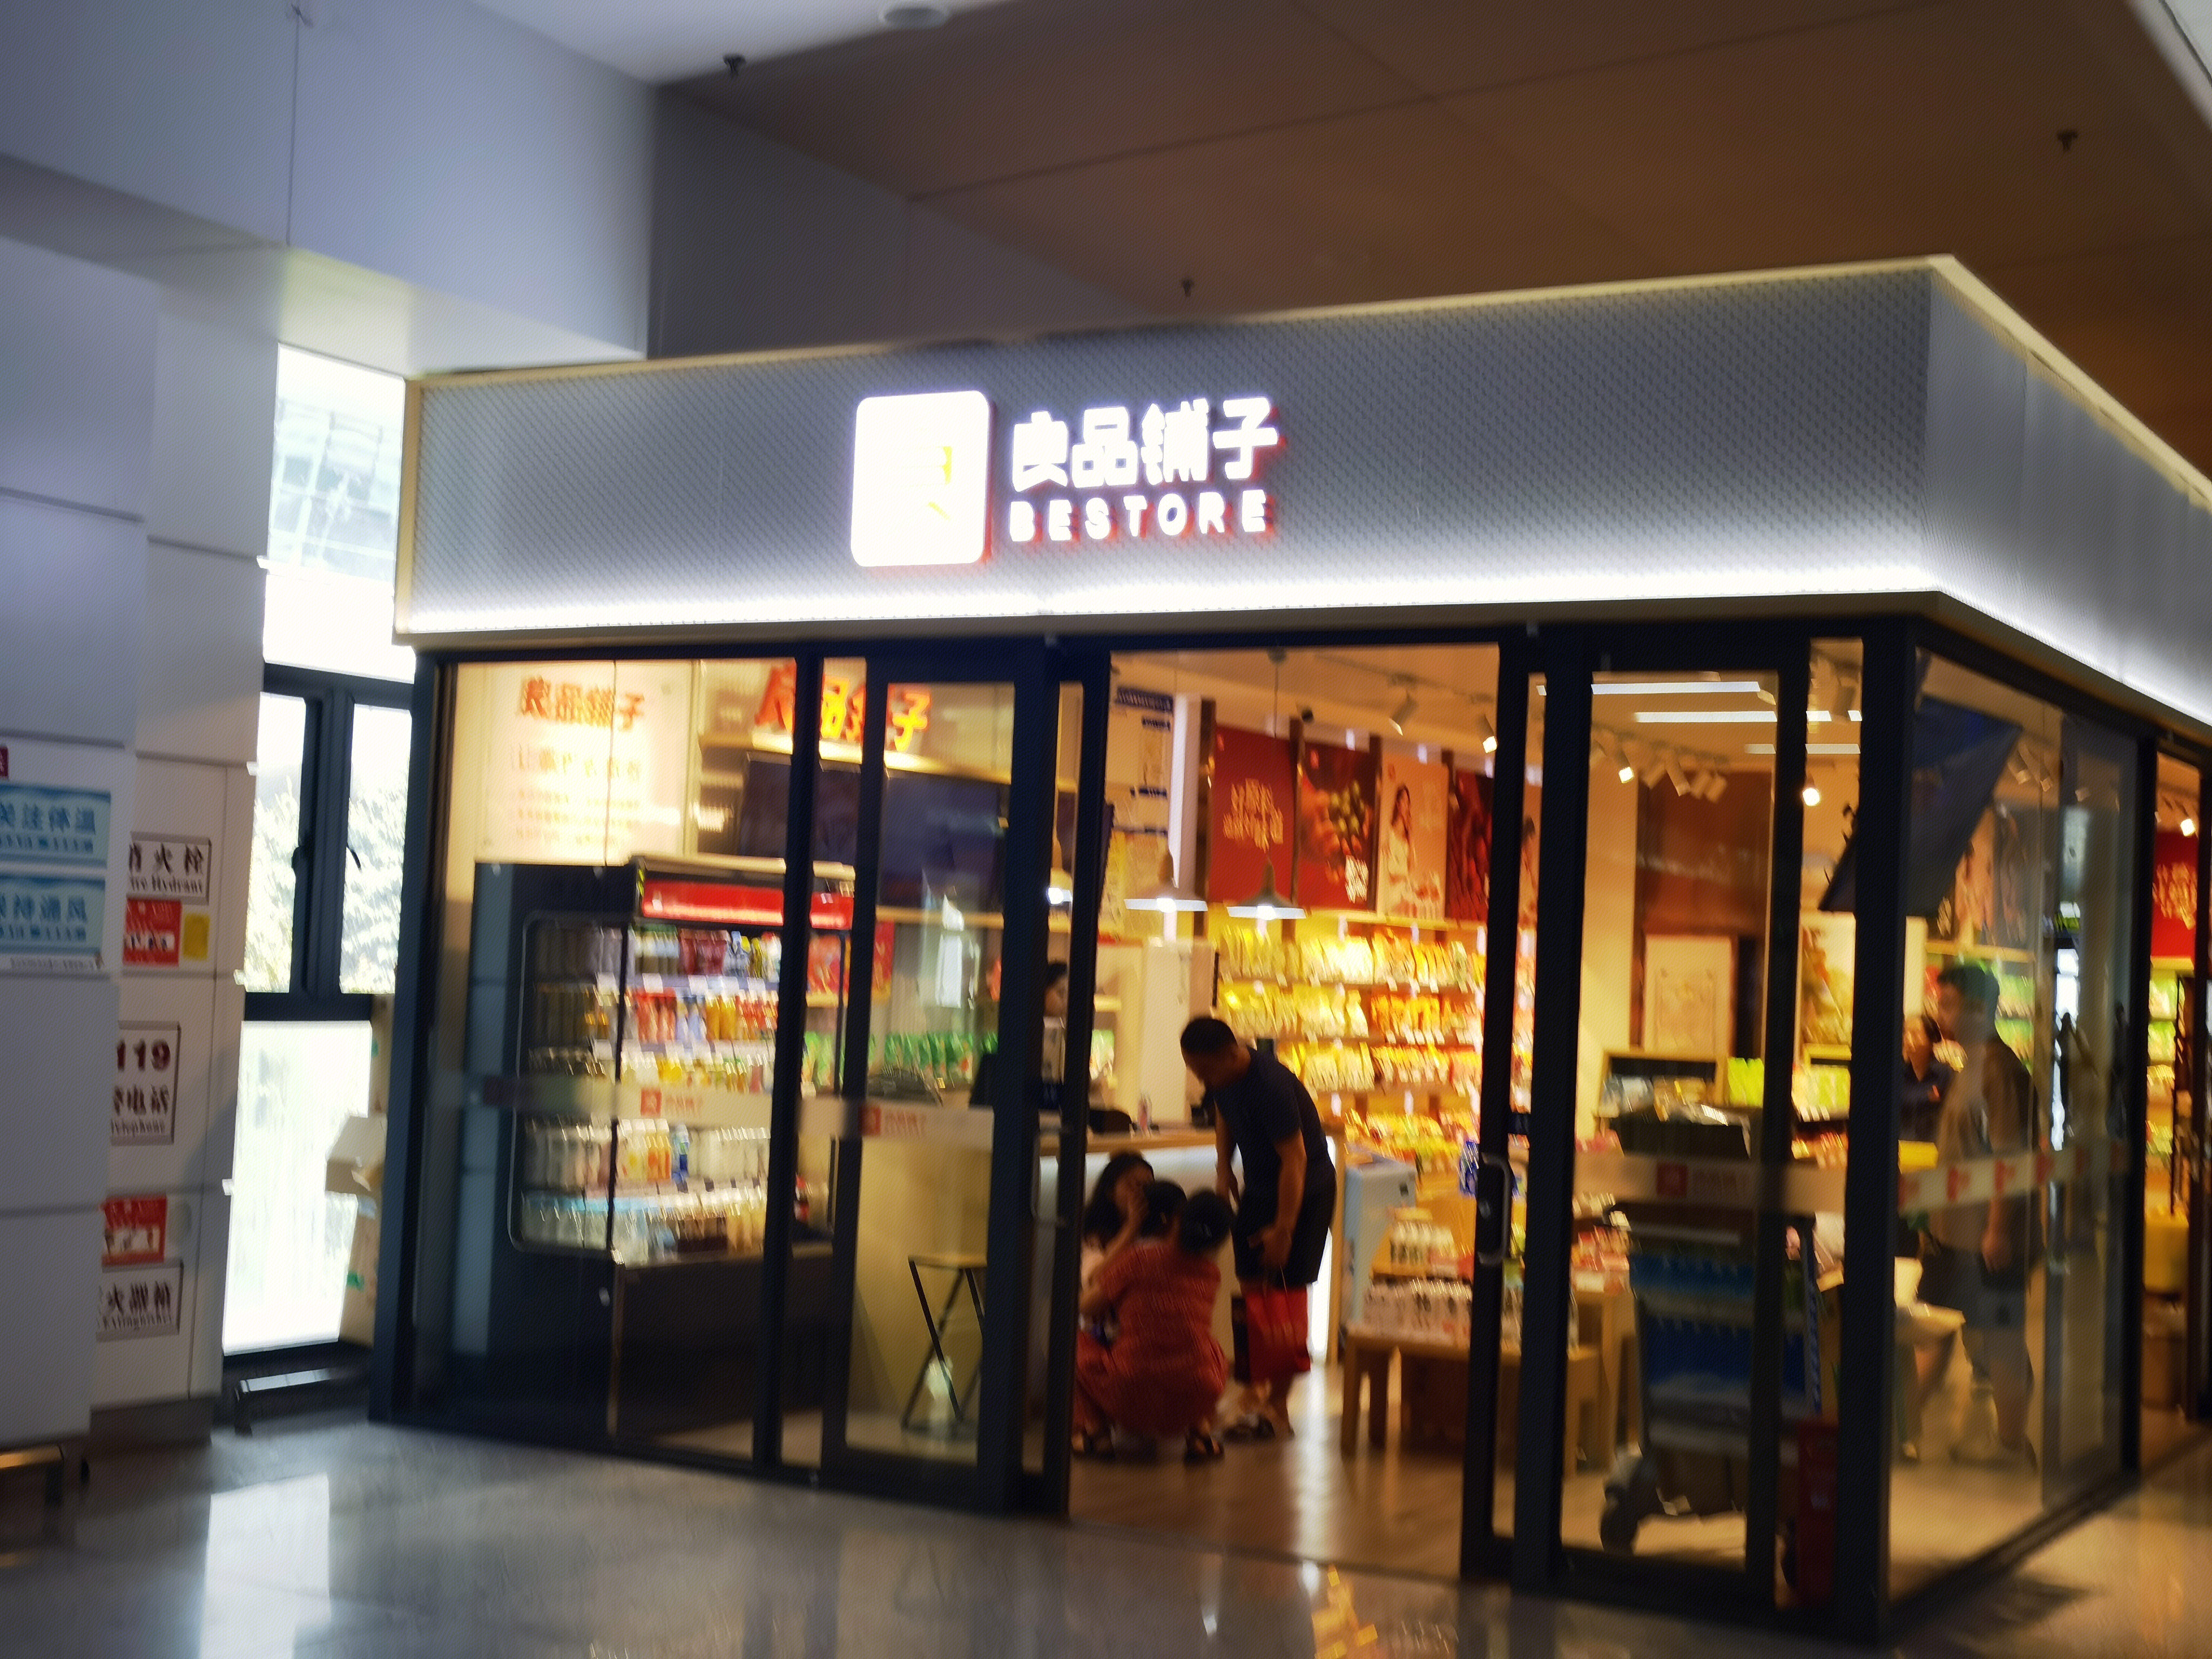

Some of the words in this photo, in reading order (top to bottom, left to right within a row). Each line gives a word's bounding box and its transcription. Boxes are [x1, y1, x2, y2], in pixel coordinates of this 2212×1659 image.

[1011, 396, 1279, 493] 良品铺子
[1009, 489, 1268, 542] BESTORE
[116, 1038, 172, 1072] 119
[98, 1280, 172, 1317] 火器箱
